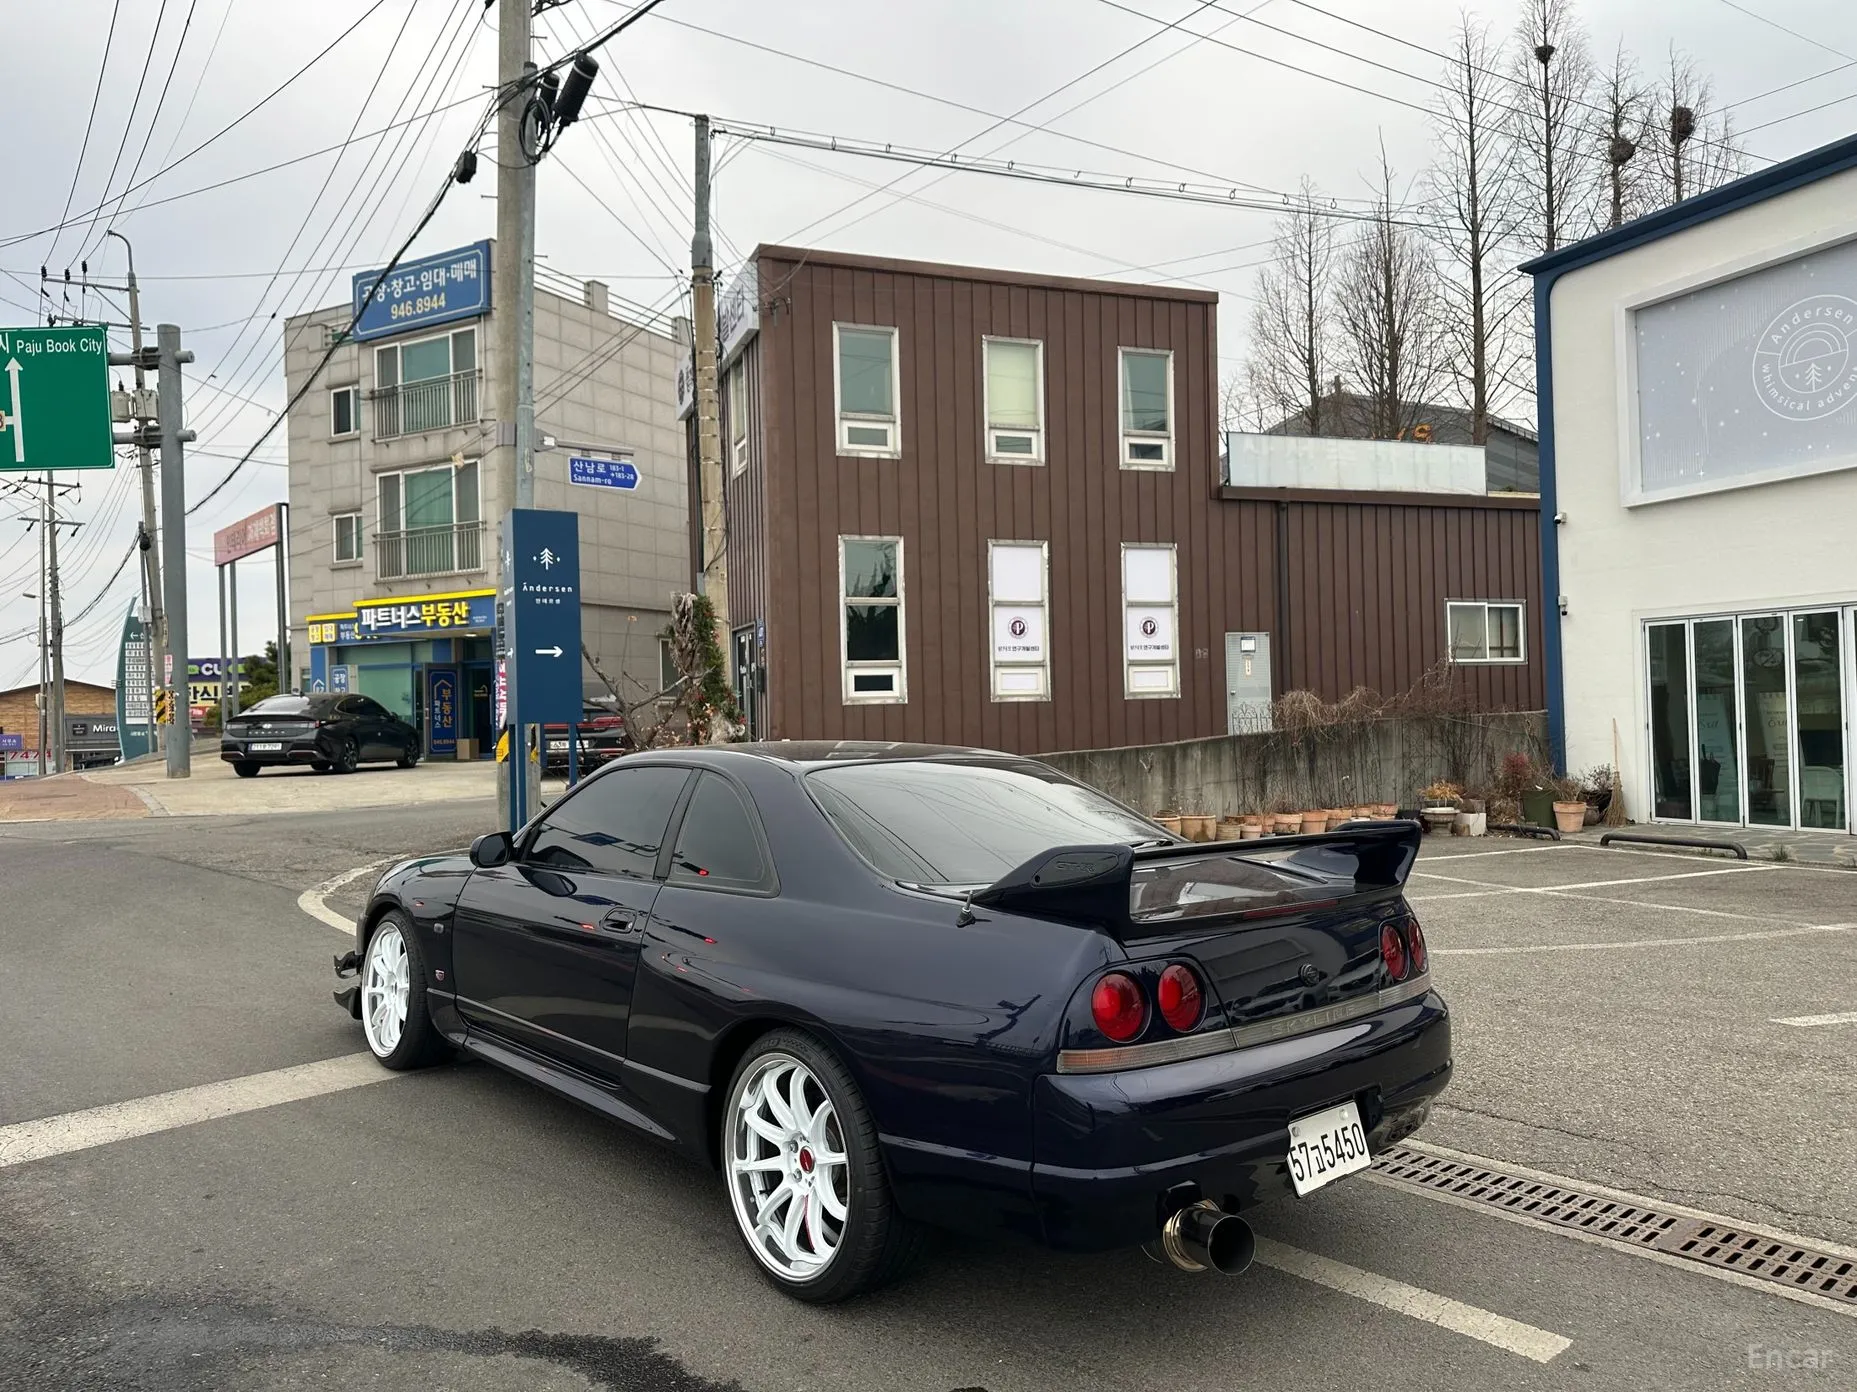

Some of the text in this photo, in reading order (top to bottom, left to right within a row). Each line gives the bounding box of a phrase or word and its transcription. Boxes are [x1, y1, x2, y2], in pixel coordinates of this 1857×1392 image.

[390, 292, 447, 320] 946.8944
[1771, 306, 1854, 344] Andersen
[17, 338, 102, 356] Paju Book City
[1761, 363, 1811, 411] whimsical
[573, 460, 607, 474] 산남로
[573, 474, 612, 485] Sannam-ro
[441, 688, 453, 728] 부동산
[92, 724, 119, 733] Mira
[1271, 1006, 1355, 1036] SKYLINE
[1289, 1122, 1366, 1182] 57고5450
